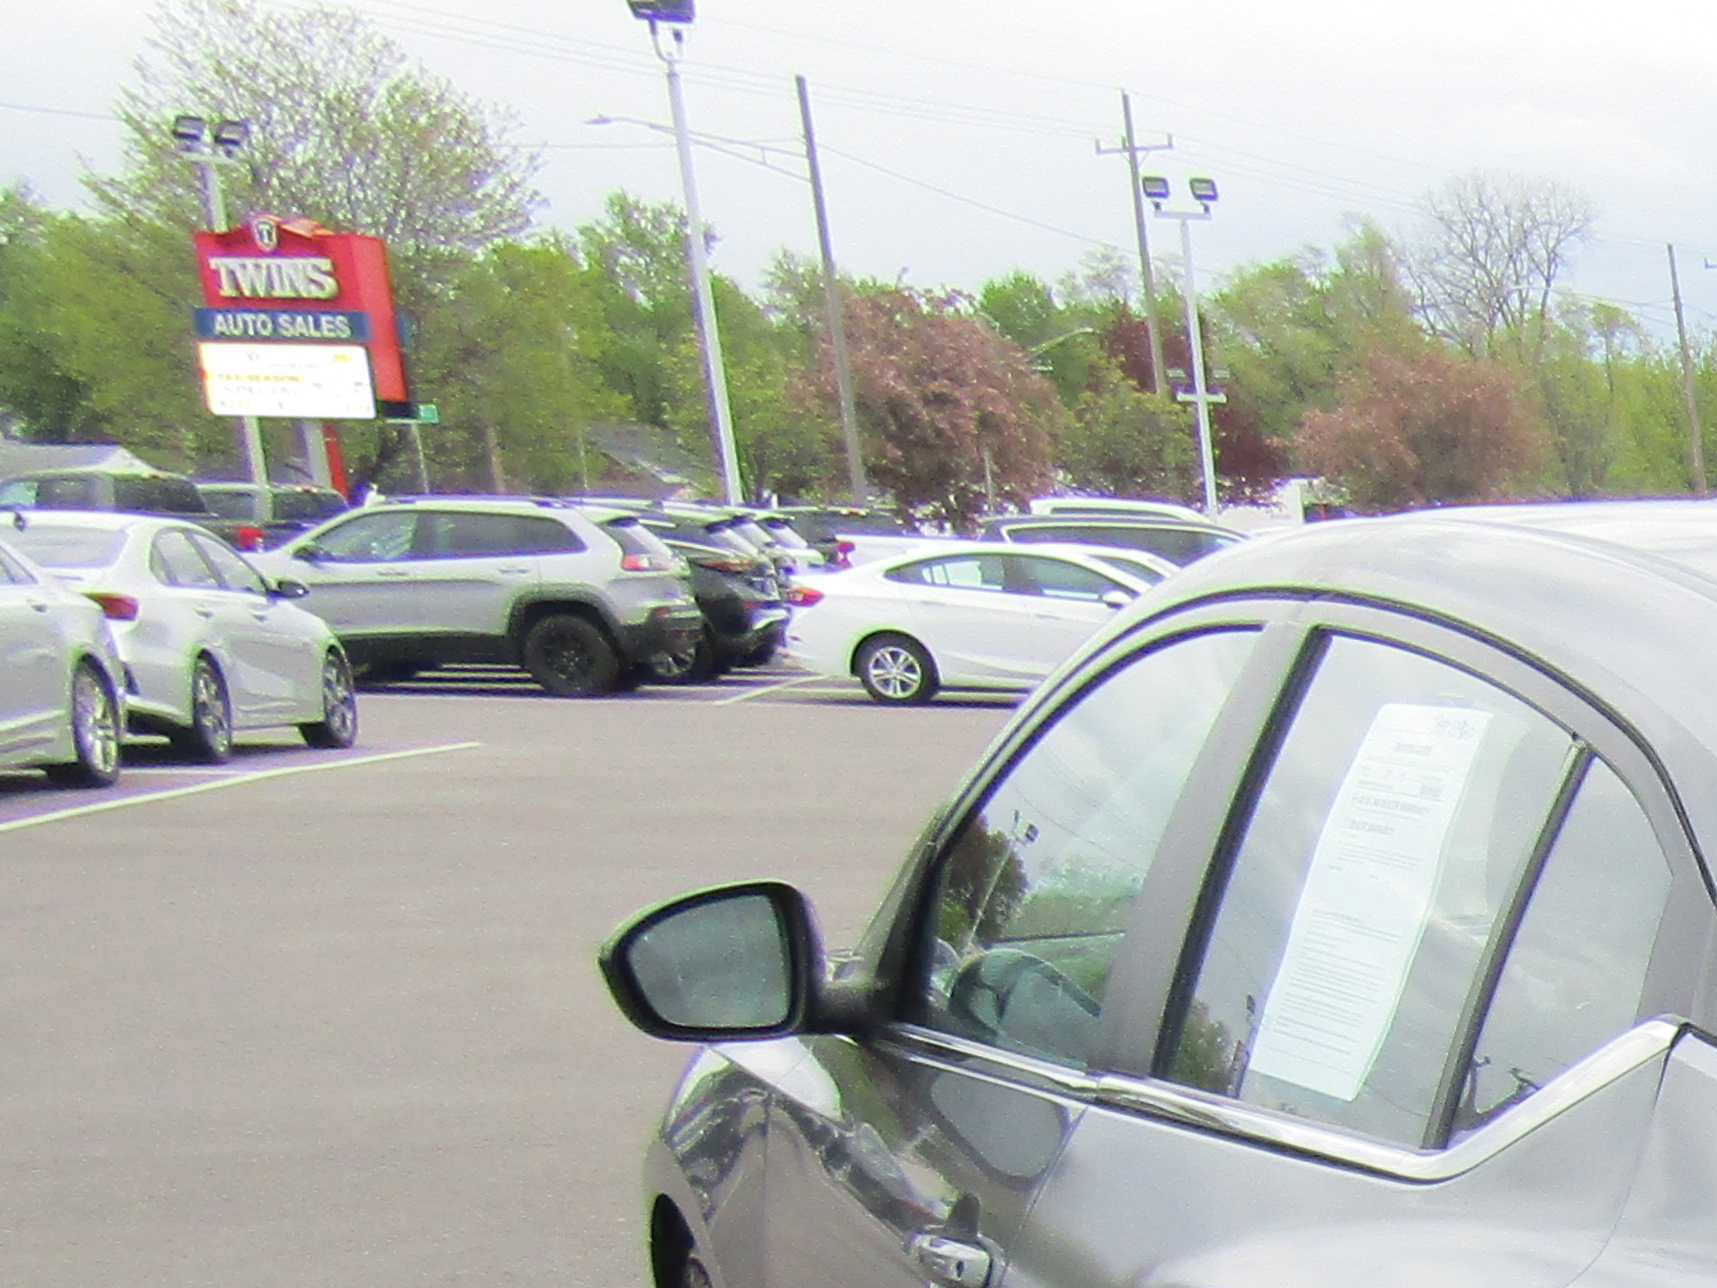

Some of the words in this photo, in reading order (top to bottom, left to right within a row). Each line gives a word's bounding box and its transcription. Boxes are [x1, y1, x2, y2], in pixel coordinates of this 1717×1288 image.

[208, 256, 340, 299] TWINS
[214, 312, 272, 336] AUTO
[277, 313, 352, 338] SALES
